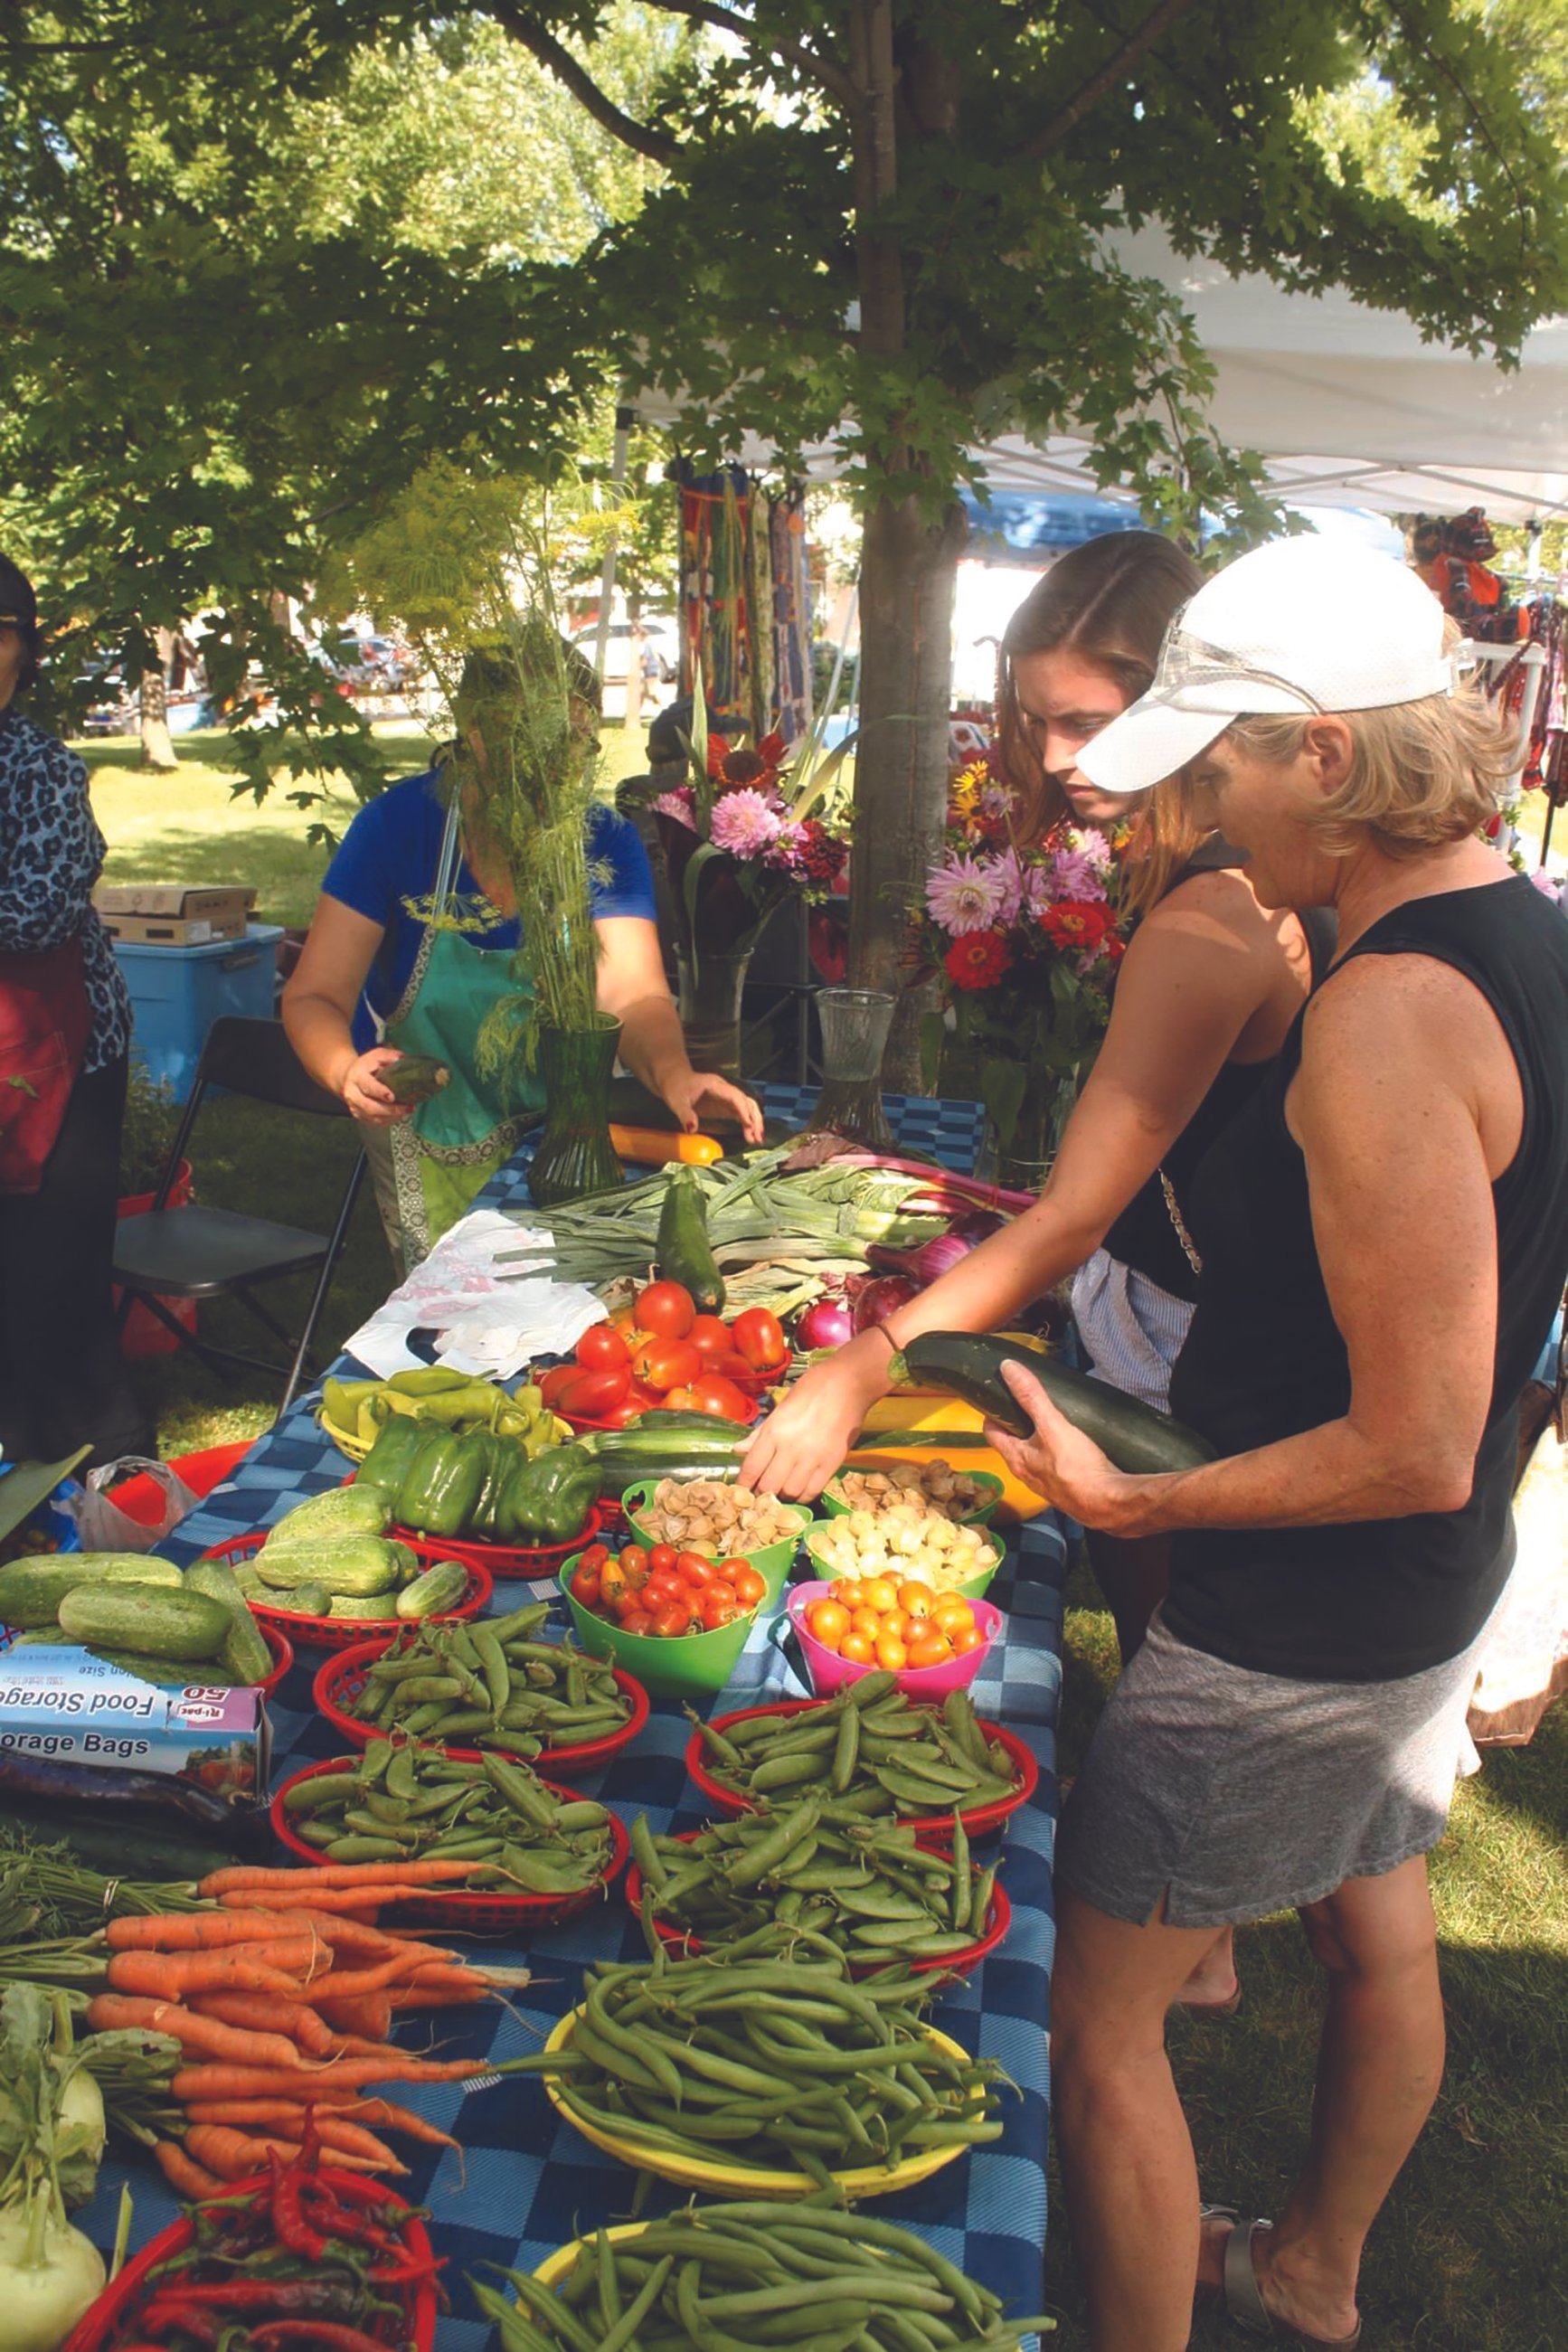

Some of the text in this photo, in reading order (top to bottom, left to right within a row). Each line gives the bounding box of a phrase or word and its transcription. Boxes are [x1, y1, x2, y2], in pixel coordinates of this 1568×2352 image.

[79, 1666, 107, 1677] Size
[184, 1686, 227, 1701] 50
[90, 1694, 154, 1716] Food
[0, 1733, 148, 1758] orage Bags
